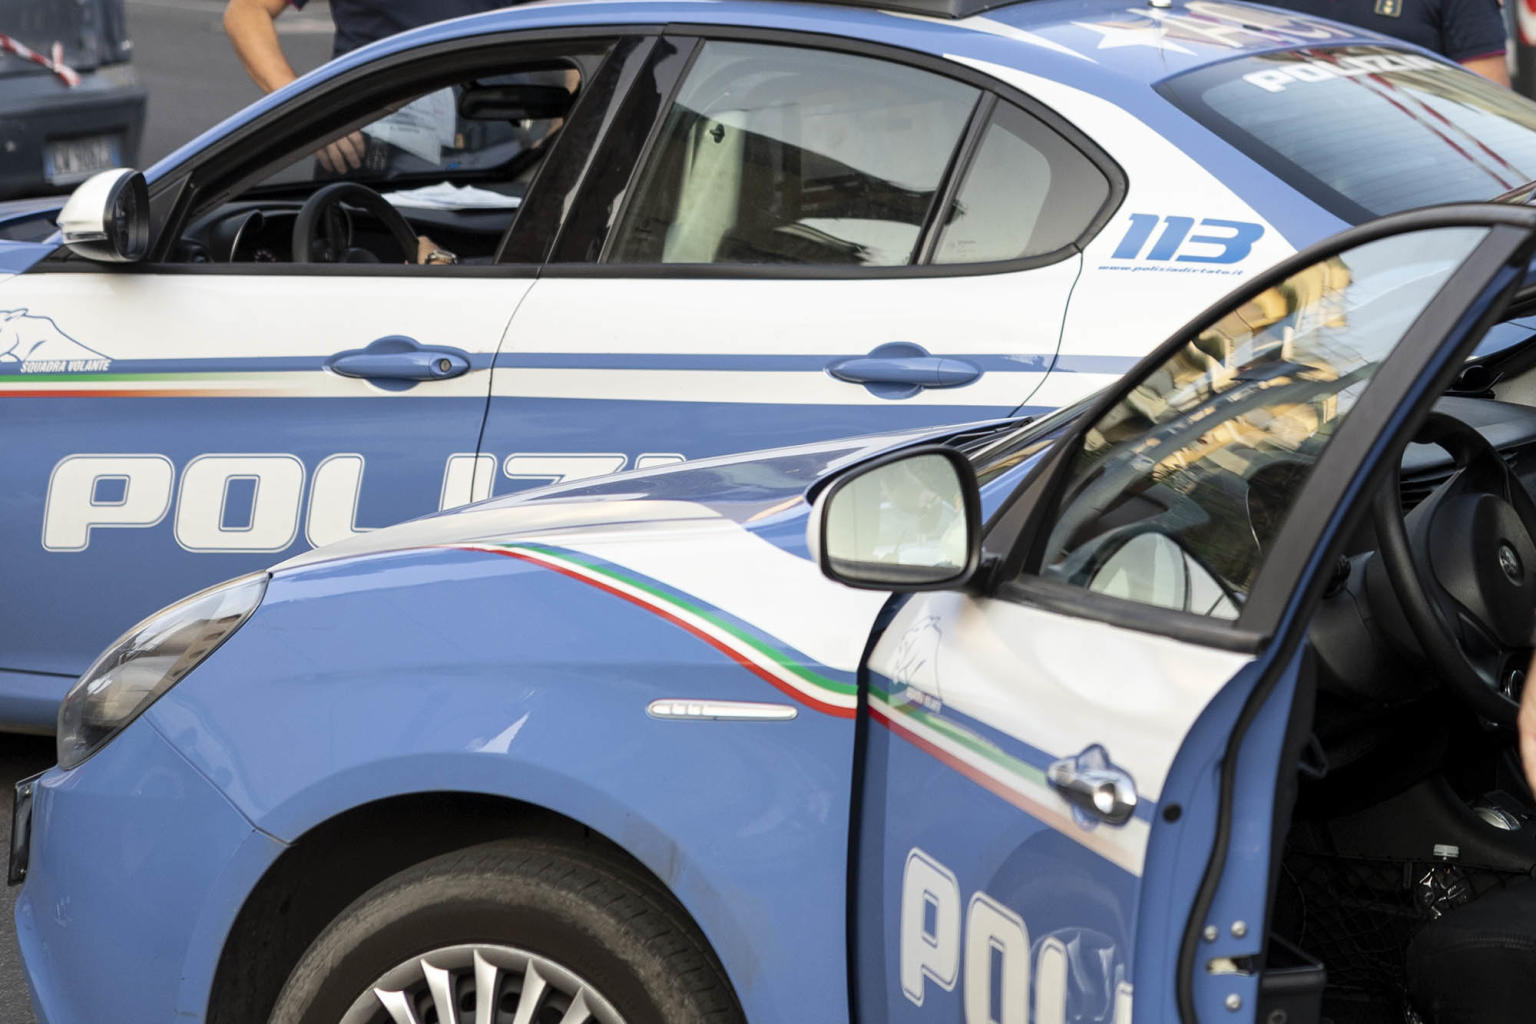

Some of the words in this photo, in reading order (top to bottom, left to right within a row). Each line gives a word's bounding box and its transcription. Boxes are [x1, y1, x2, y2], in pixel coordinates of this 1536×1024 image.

[1111, 213, 1265, 265] 113
[21, 360, 67, 373] SQUADRA
[68, 359, 111, 372] VOLANTE
[41, 453, 688, 553] POLI
